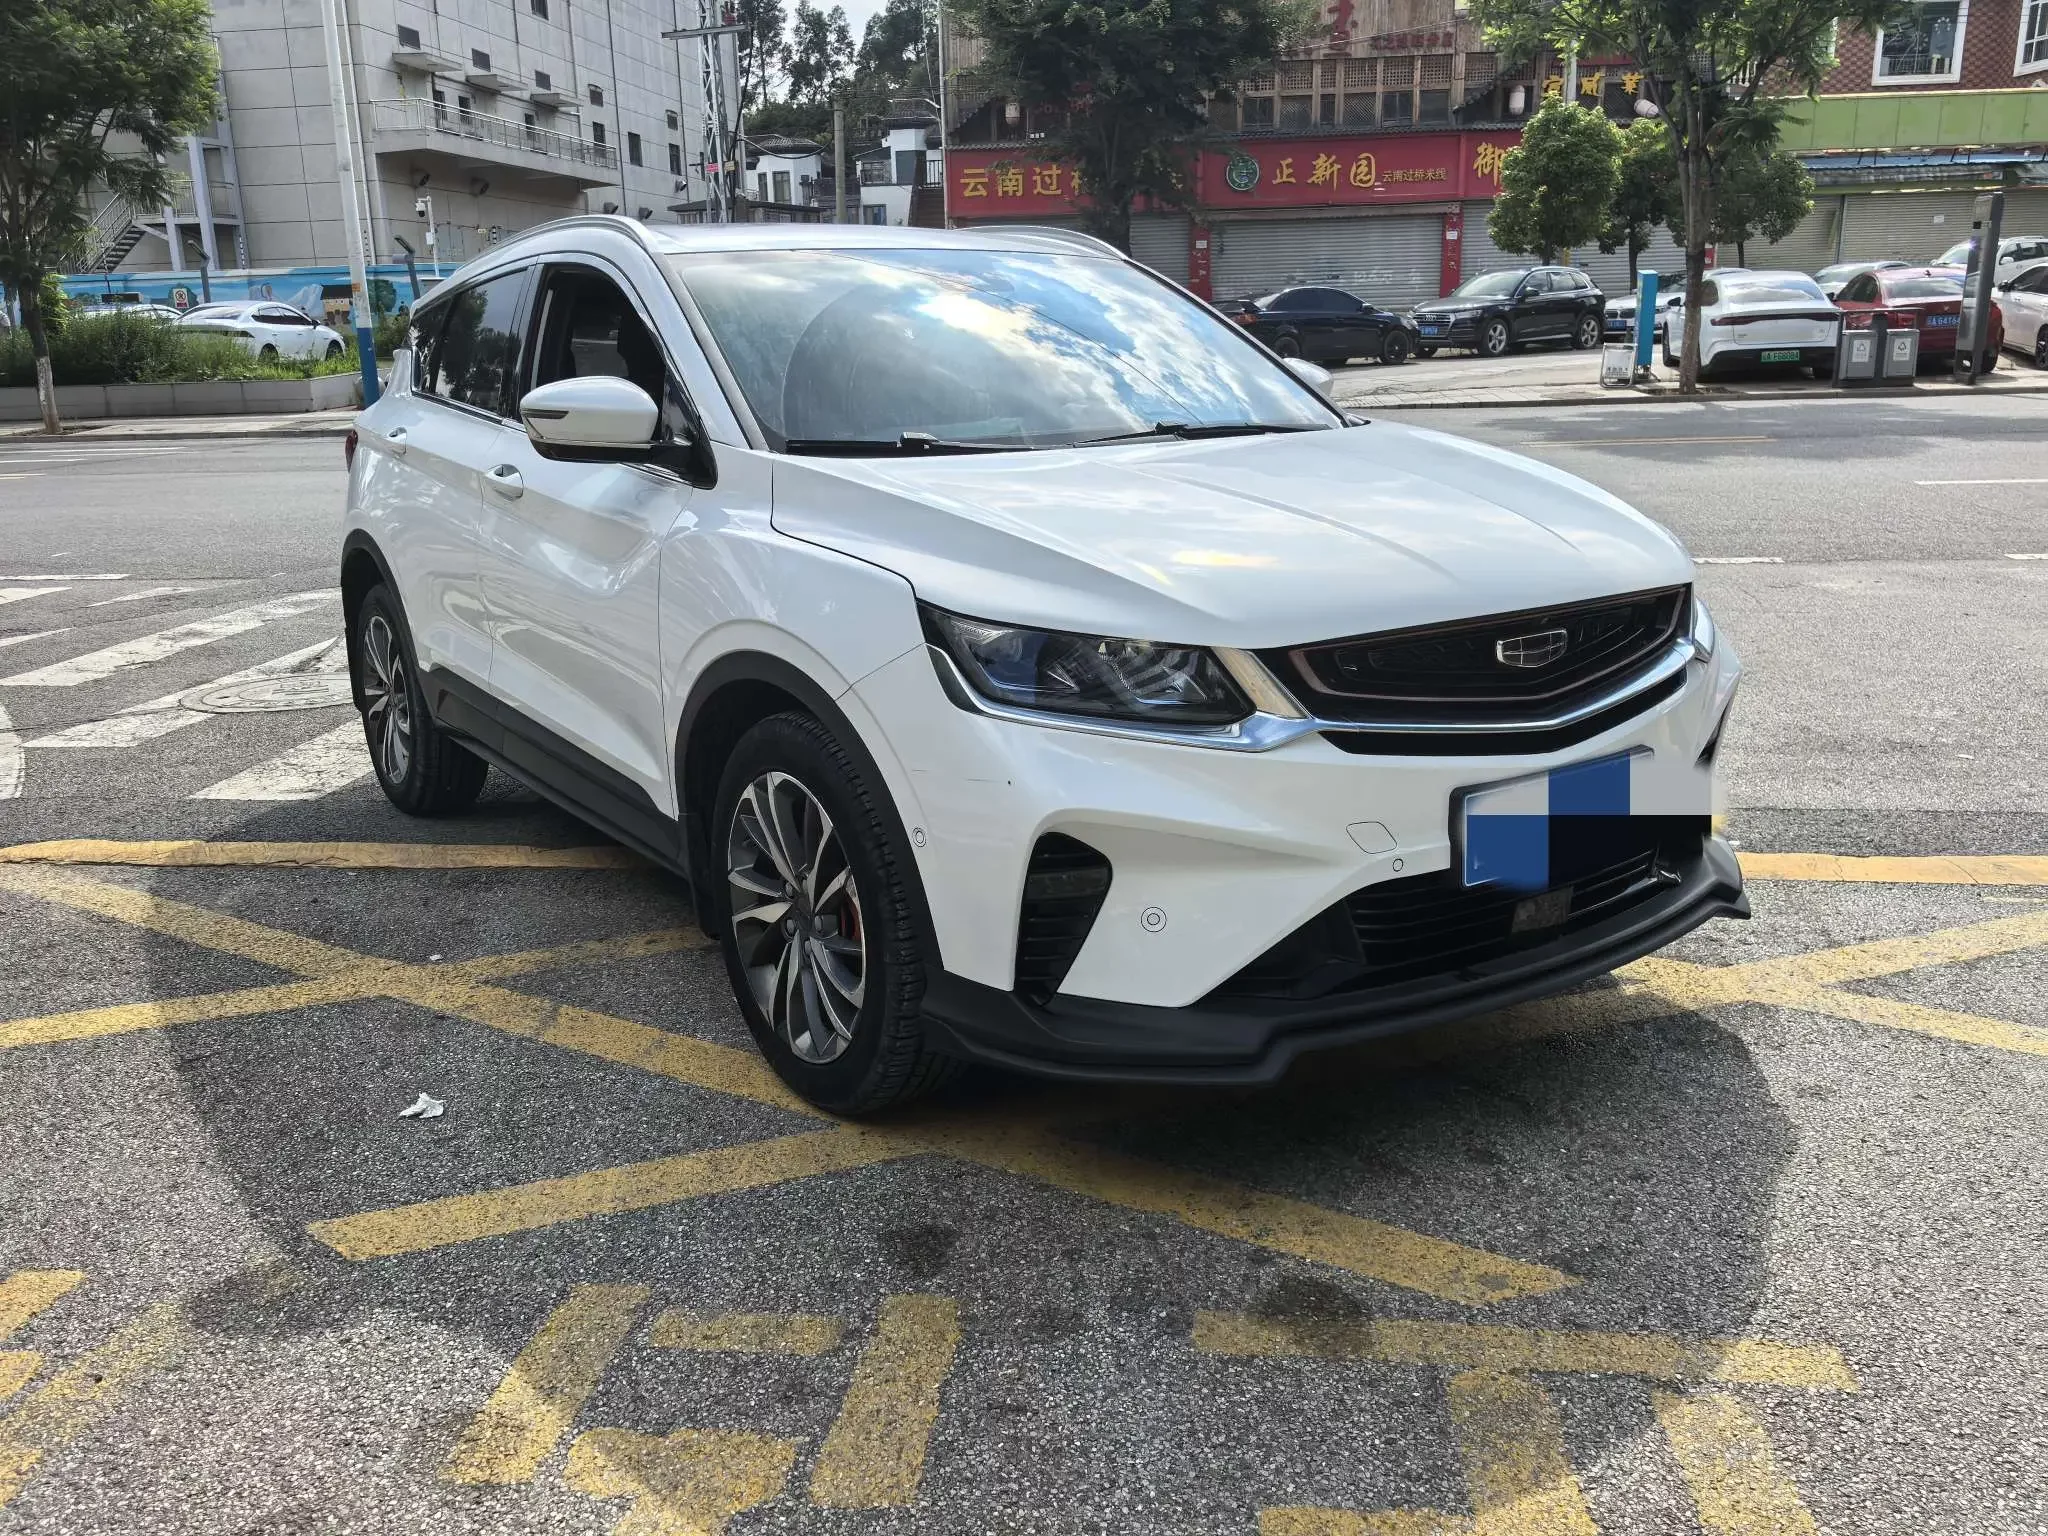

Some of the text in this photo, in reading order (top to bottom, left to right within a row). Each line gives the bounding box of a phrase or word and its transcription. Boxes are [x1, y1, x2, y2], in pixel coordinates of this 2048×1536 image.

[1272, 153, 1376, 192] 正新园
[1382, 167, 1448, 183] 云南过桥米线
